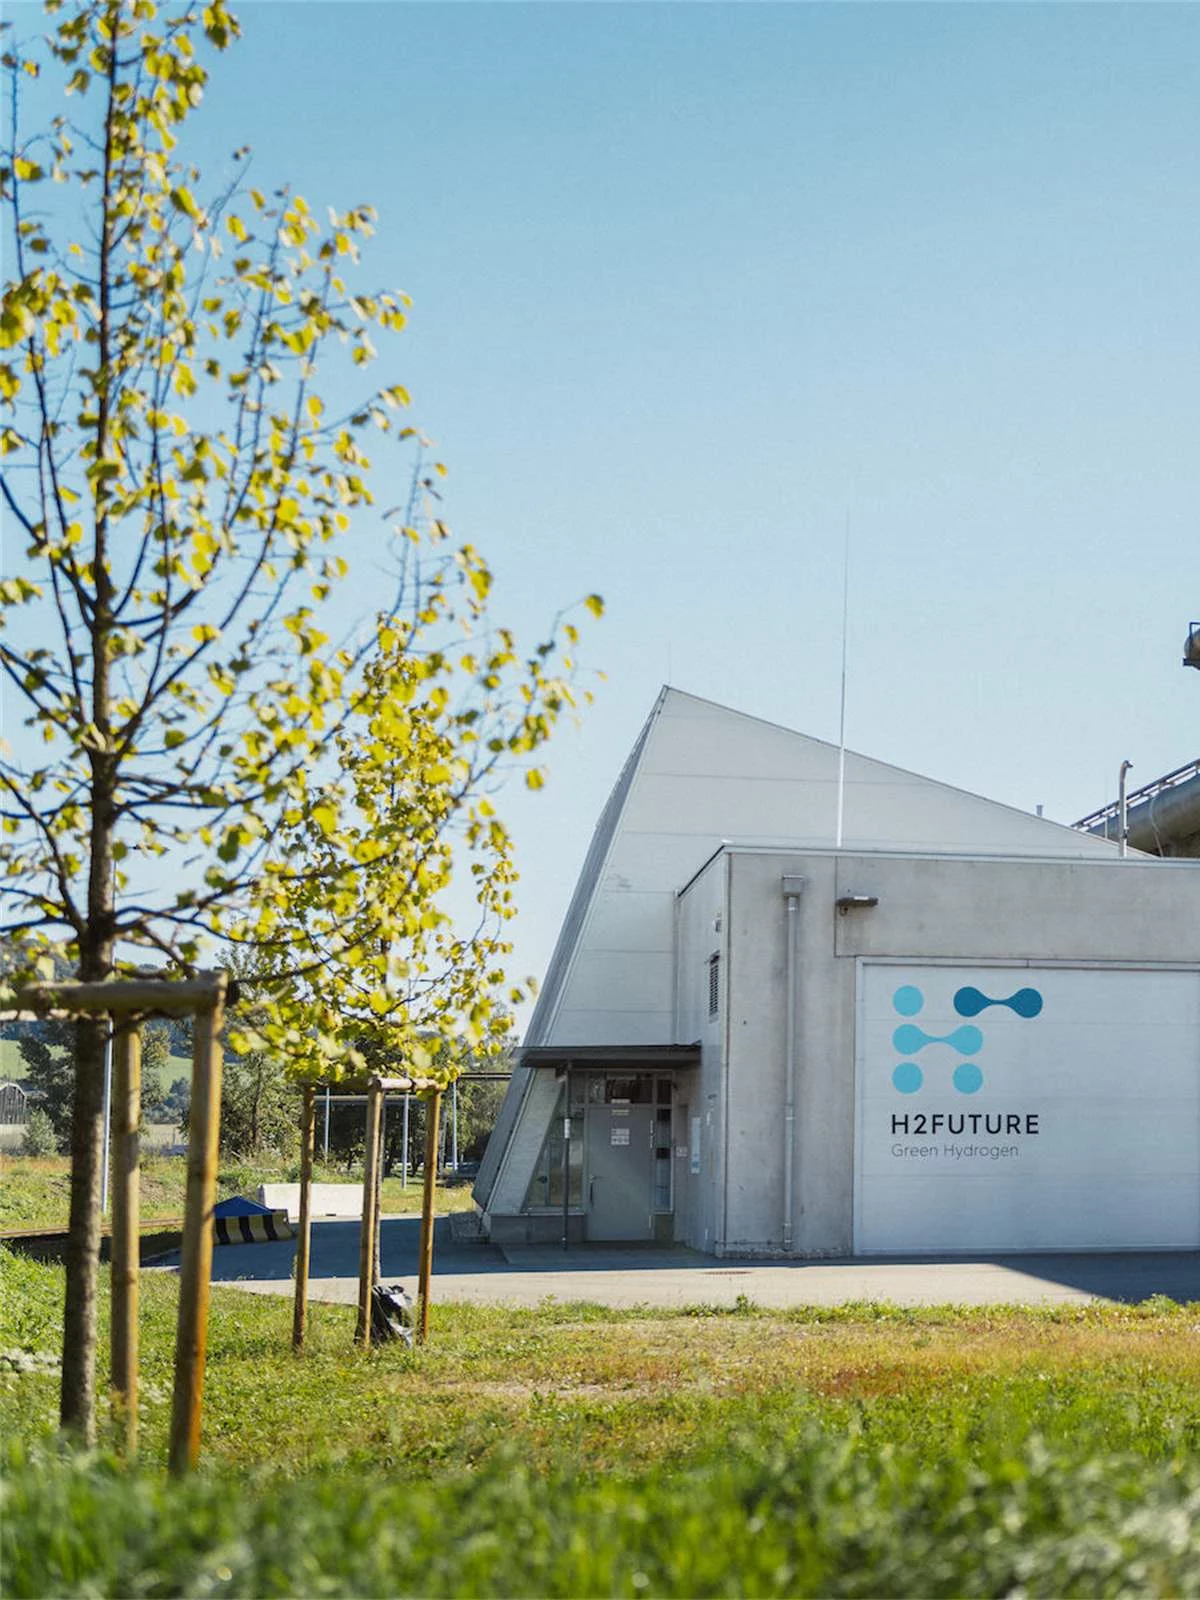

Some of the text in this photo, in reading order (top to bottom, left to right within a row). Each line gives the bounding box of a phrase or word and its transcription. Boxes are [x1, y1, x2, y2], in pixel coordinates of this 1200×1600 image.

[891, 1114, 1039, 1135] H2FUTURE
[891, 1144, 1019, 1160] Green Hydrogen
